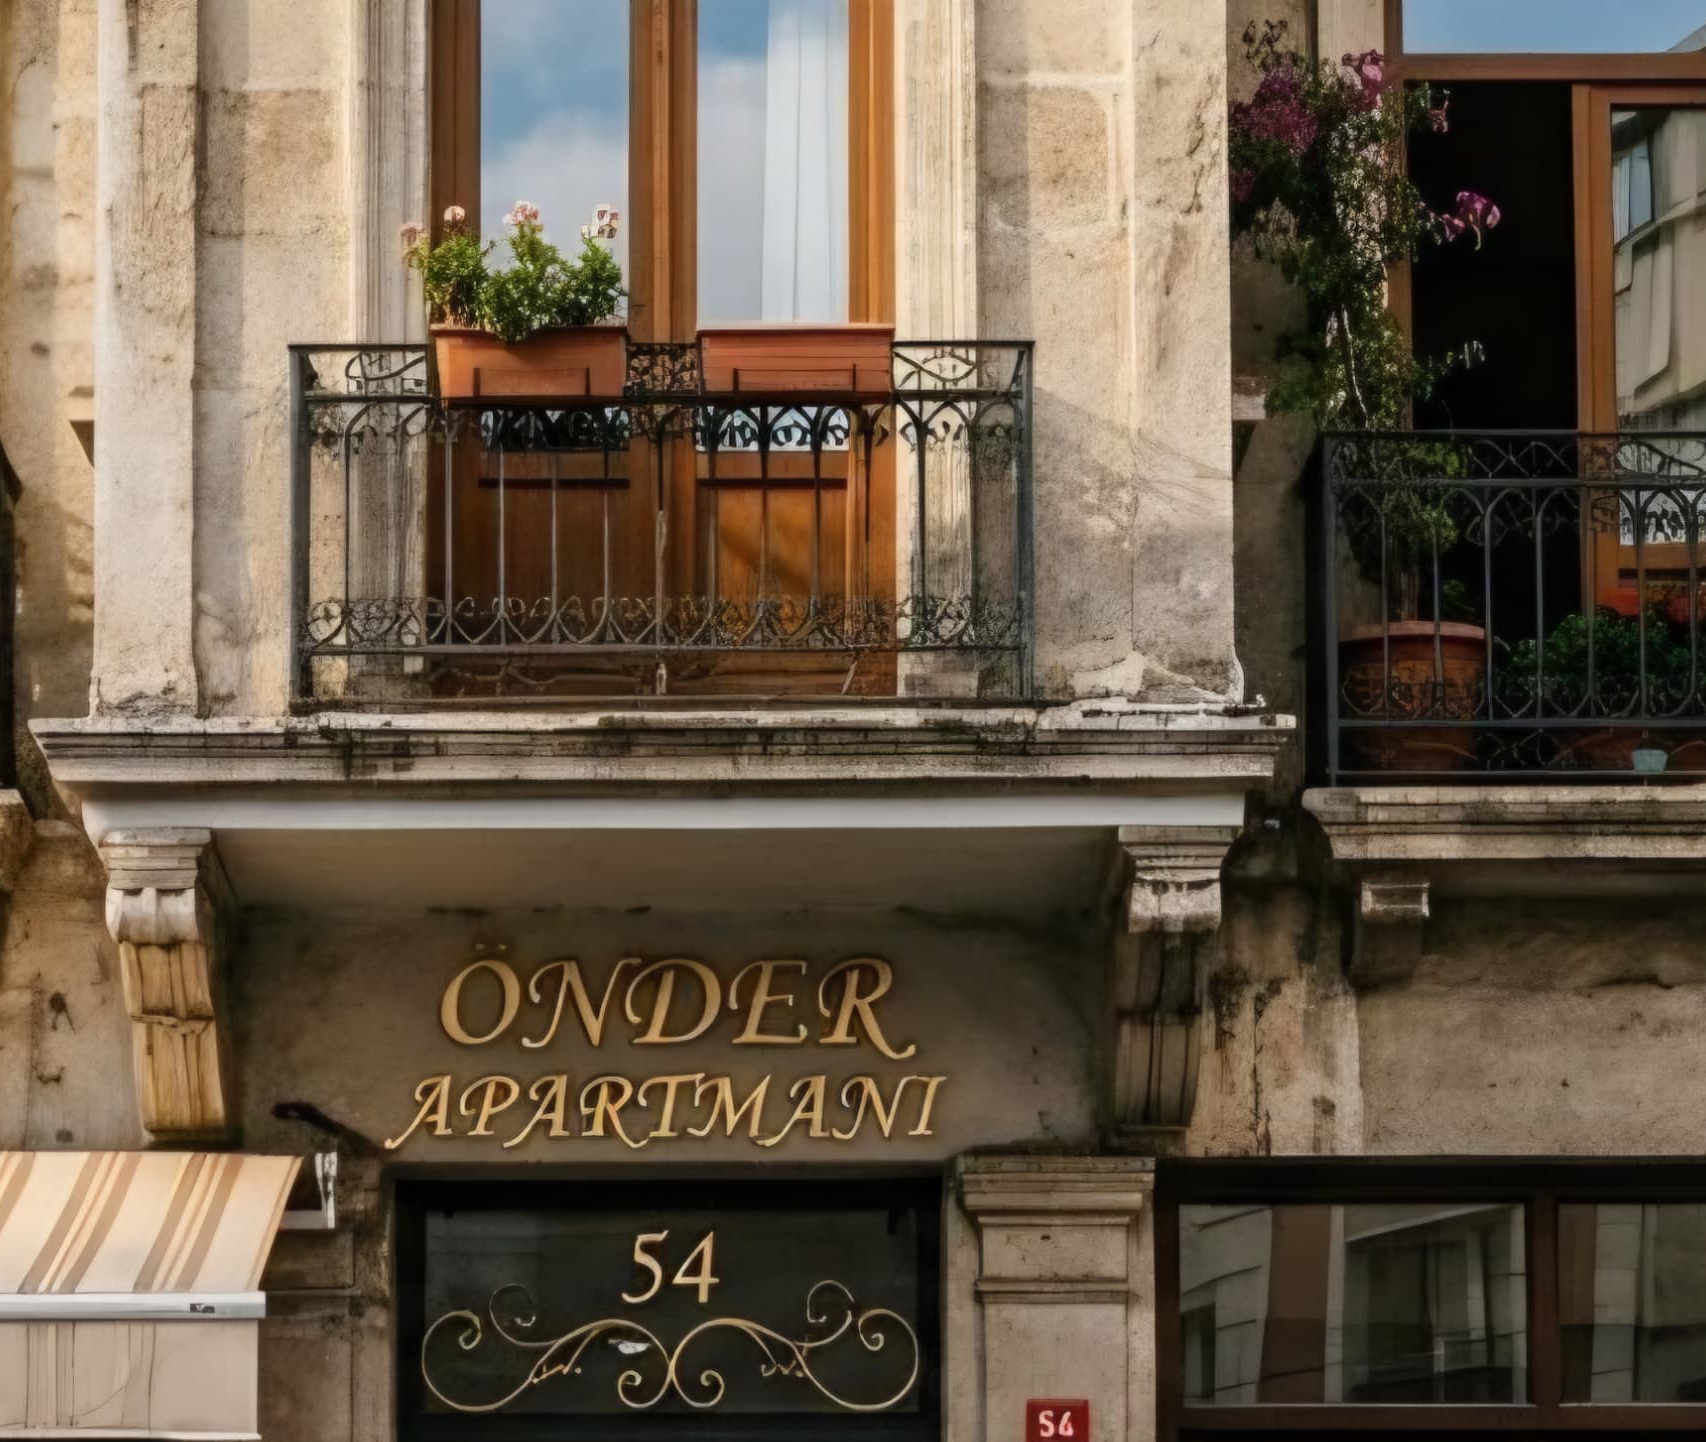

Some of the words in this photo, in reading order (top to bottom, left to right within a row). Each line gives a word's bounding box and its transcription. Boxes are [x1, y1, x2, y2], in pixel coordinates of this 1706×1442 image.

[439, 941, 916, 1060] ÖNDER
[385, 1073, 947, 1150] APARTMANI
[622, 1230, 720, 1305] 54
